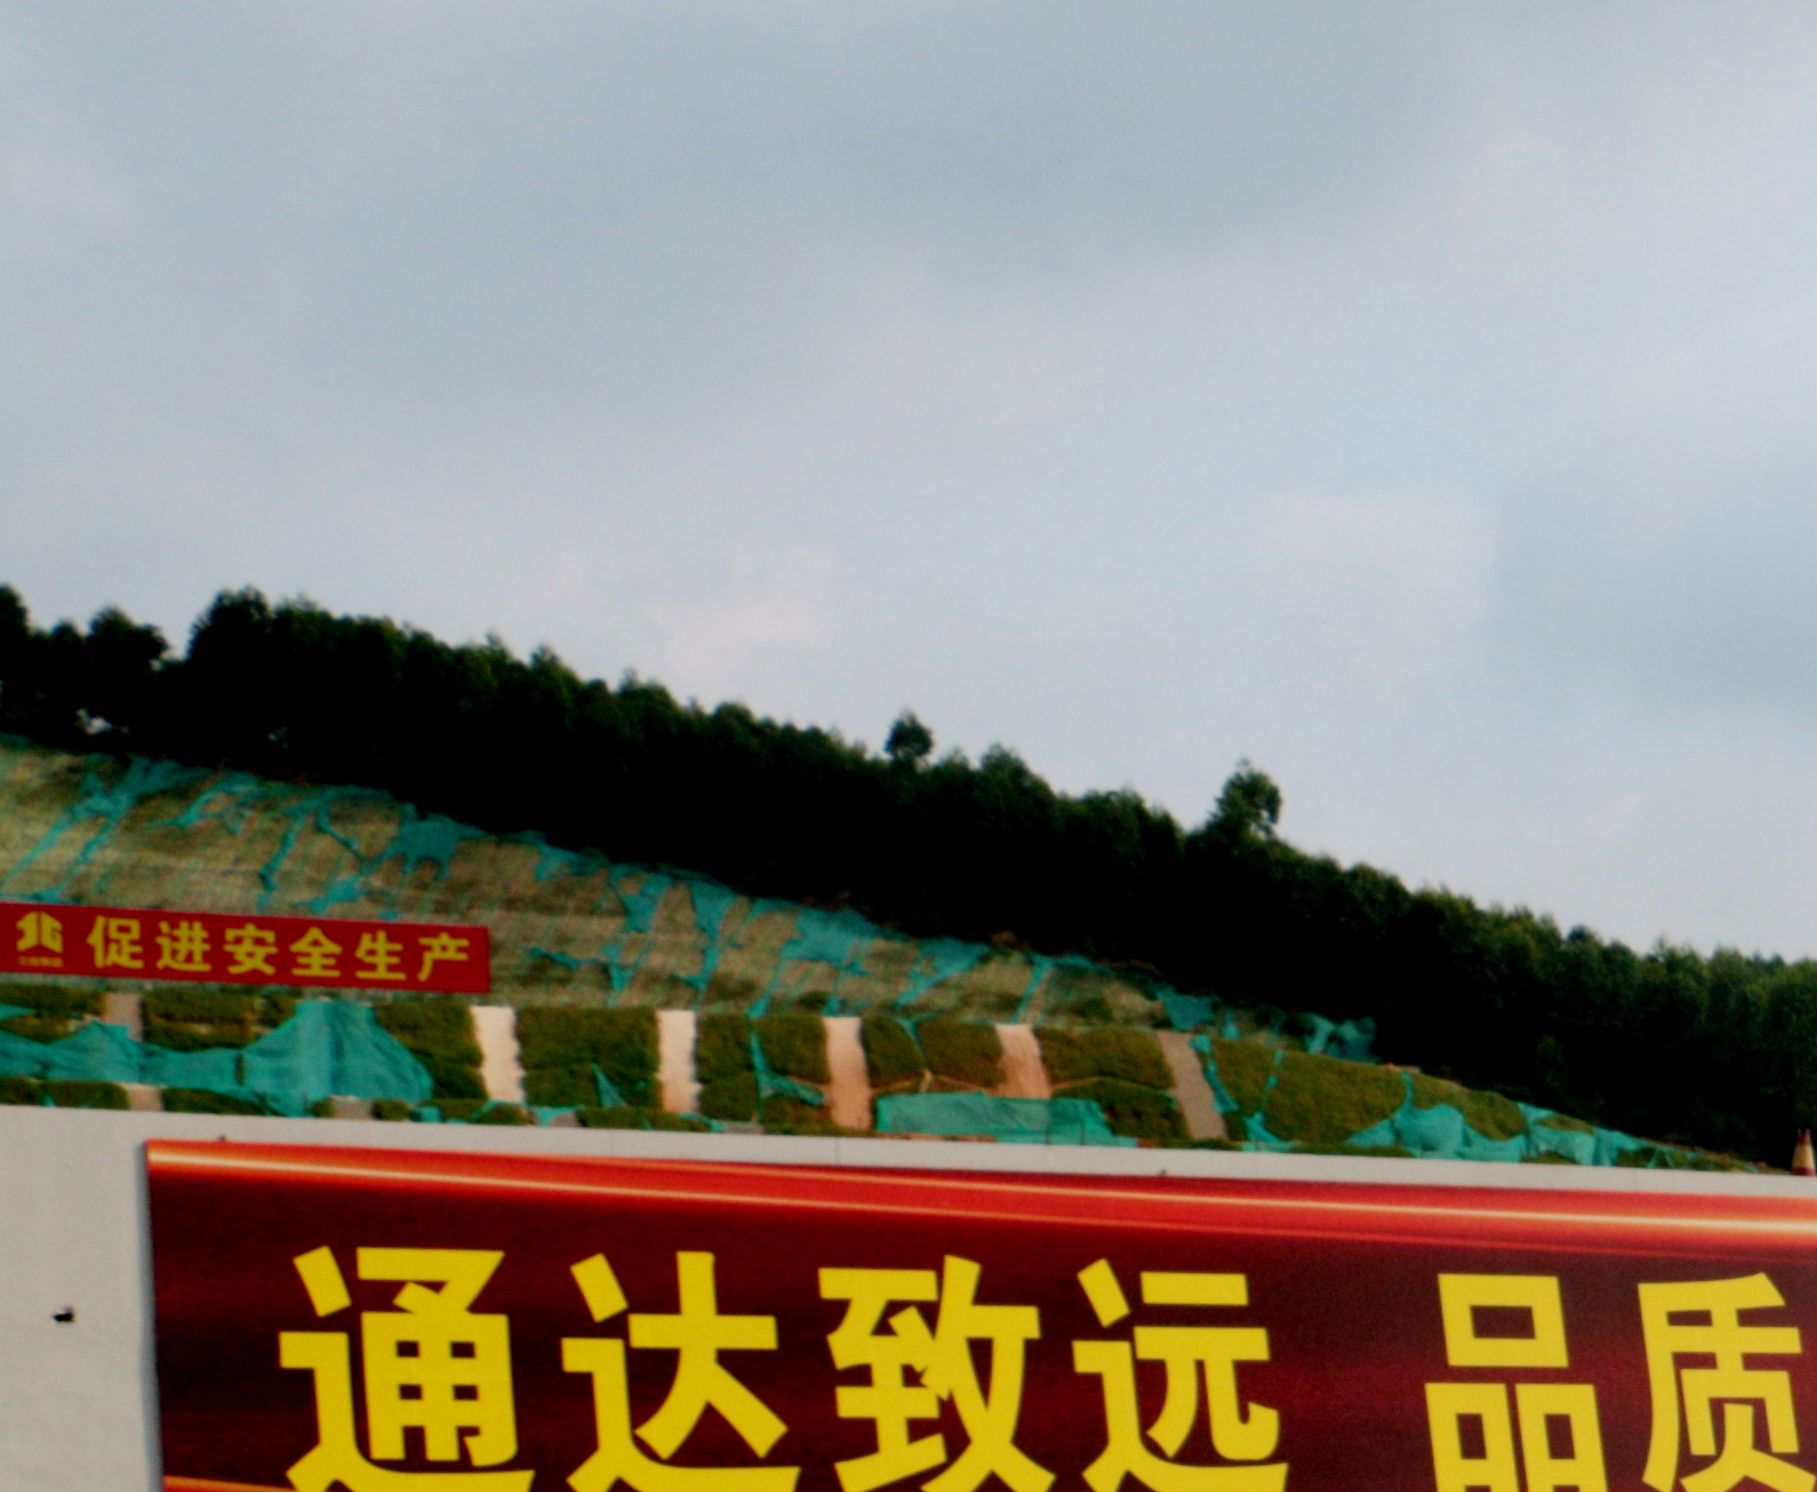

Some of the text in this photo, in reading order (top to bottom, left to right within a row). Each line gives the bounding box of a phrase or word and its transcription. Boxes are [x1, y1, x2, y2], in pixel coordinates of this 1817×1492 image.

[87, 915, 470, 982] 促进安全生产
